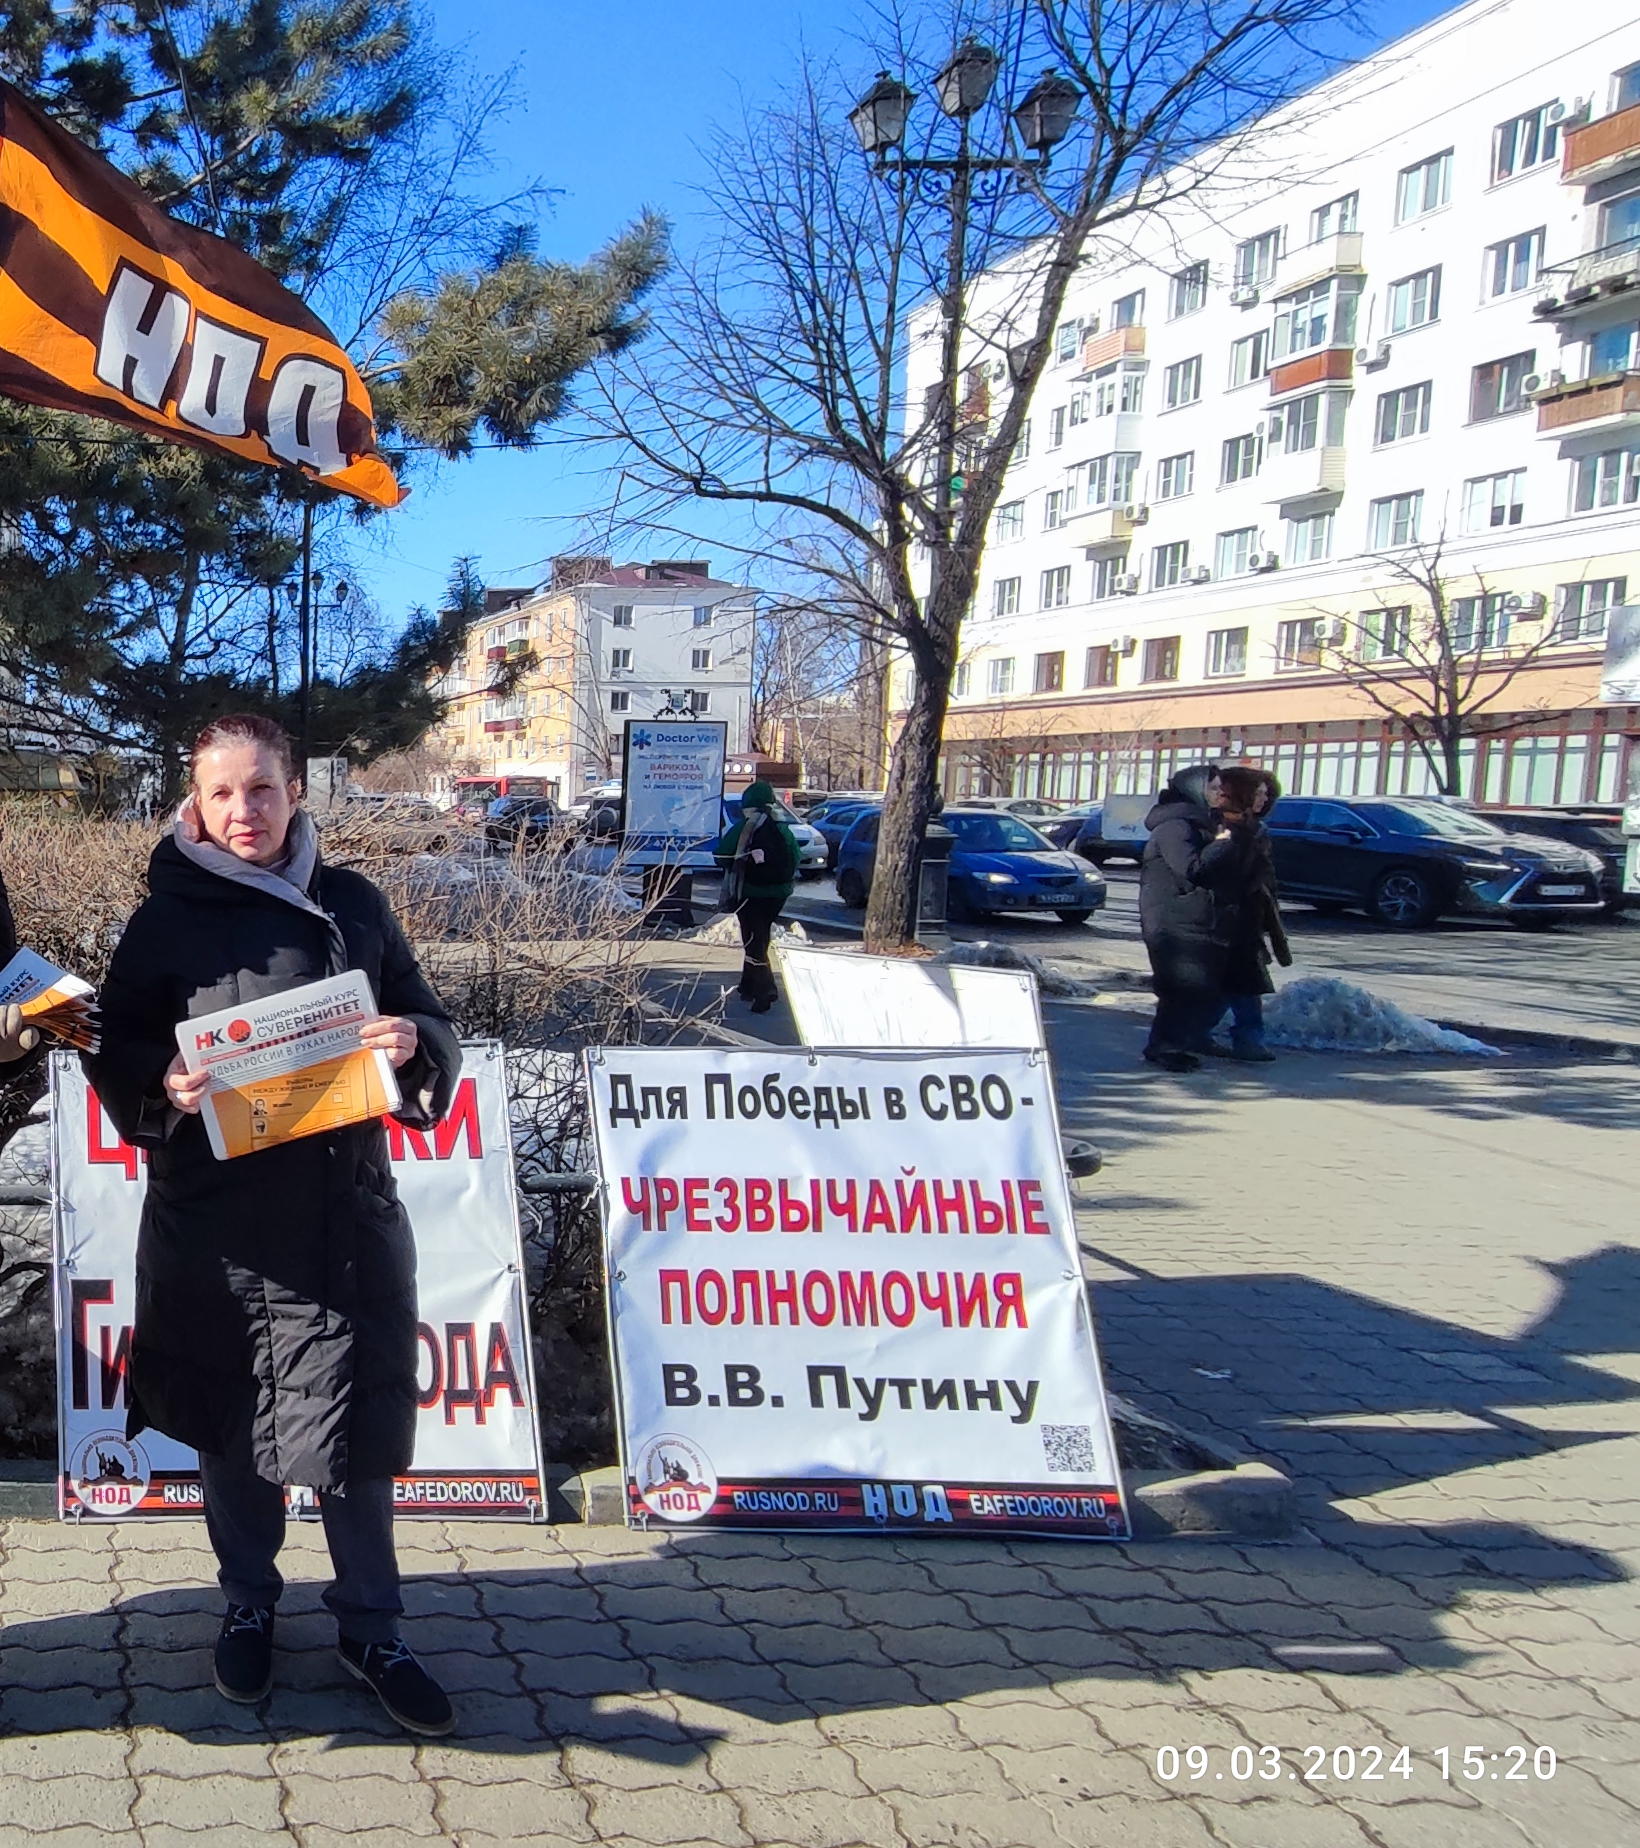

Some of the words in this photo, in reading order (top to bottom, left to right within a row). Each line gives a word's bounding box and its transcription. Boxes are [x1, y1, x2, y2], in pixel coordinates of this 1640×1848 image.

[96, 257, 350, 476] НОД
[656, 733, 696, 743] Doctor
[650, 763, 701, 771] ВАРИКОЗА
[653, 772, 704, 781] ГЕМОРРОЯ
[253, 995, 333, 1026] НАЦИОНАЛЬНЫЙ
[334, 988, 359, 1004] КУРС
[256, 998, 361, 1039] СУВЕРЕНИТЕТ
[195, 1028, 226, 1051] НК
[243, 1048, 285, 1068] РОССИИ
[286, 1046, 294, 1057] В
[294, 1035, 327, 1055] РУКАХ
[326, 1024, 365, 1043] НАРОД
[610, 1073, 688, 1128] Для
[704, 1073, 871, 1129] Победы
[884, 1087, 907, 1120] в
[621, 1166, 1051, 1235] ЧРЕЗВЫЧАЙНЫЕ
[658, 1268, 1029, 1329] ПОЛНОМОЧИЯ
[662, 1363, 784, 1408] В.В.
[807, 1364, 1041, 1424] Путину
[91, 1486, 132, 1505] НОД
[393, 1481, 525, 1503] EAFEDOROV.RU
[659, 1493, 702, 1513] НОД
[732, 1490, 840, 1514] RUSNOD.RU
[860, 1483, 954, 1523] НОД
[968, 1492, 1108, 1520] EAFEDOROV.RU
